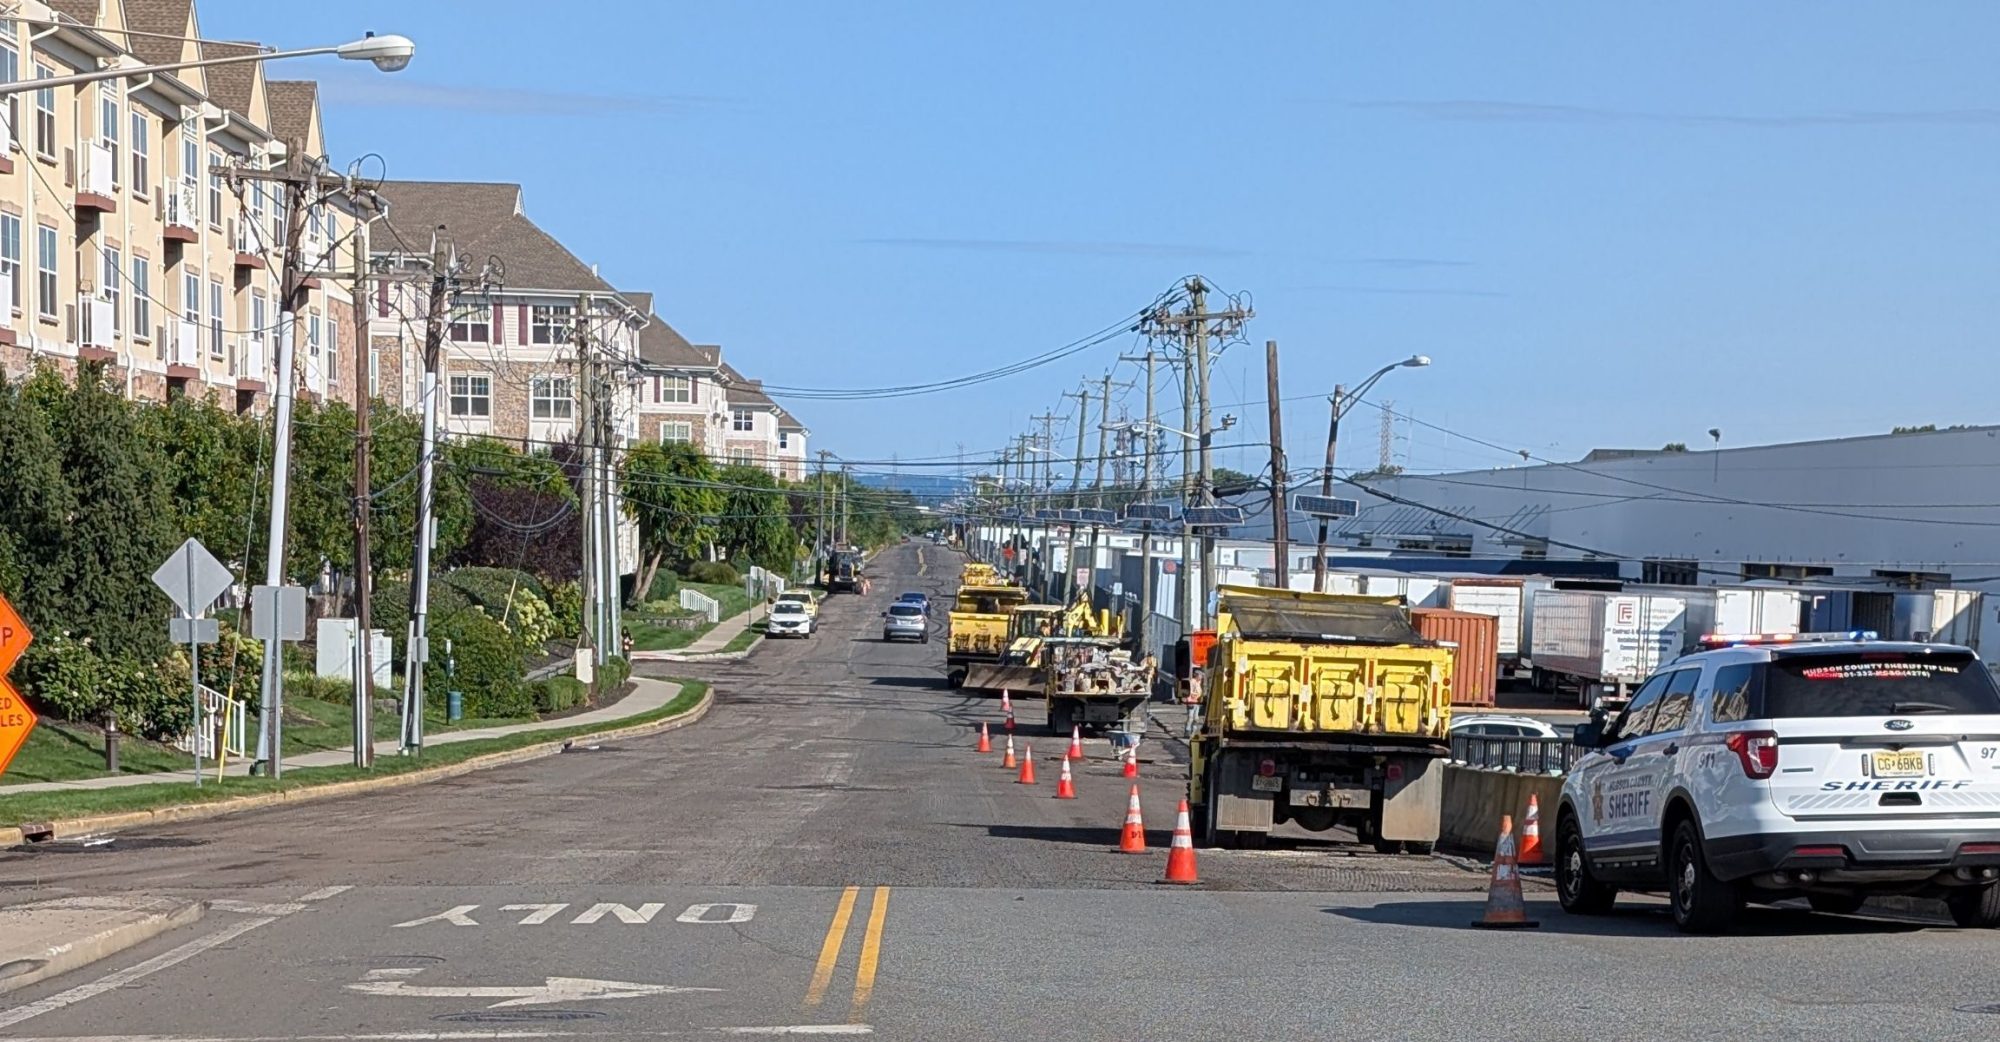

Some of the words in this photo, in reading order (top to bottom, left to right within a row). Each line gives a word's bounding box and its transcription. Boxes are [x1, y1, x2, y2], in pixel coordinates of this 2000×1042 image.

[1803, 665, 1843, 676] HUDSON
[1844, 663, 1882, 671] COUNTY
[1939, 665, 1959, 674] LINE
[1981, 747, 1997, 759] 97
[1698, 753, 1716, 769] 911
[1820, 779, 1974, 791] SHERIFF
[1608, 790, 1651, 819] SHERIFF
[391, 903, 758, 928] ONLY
